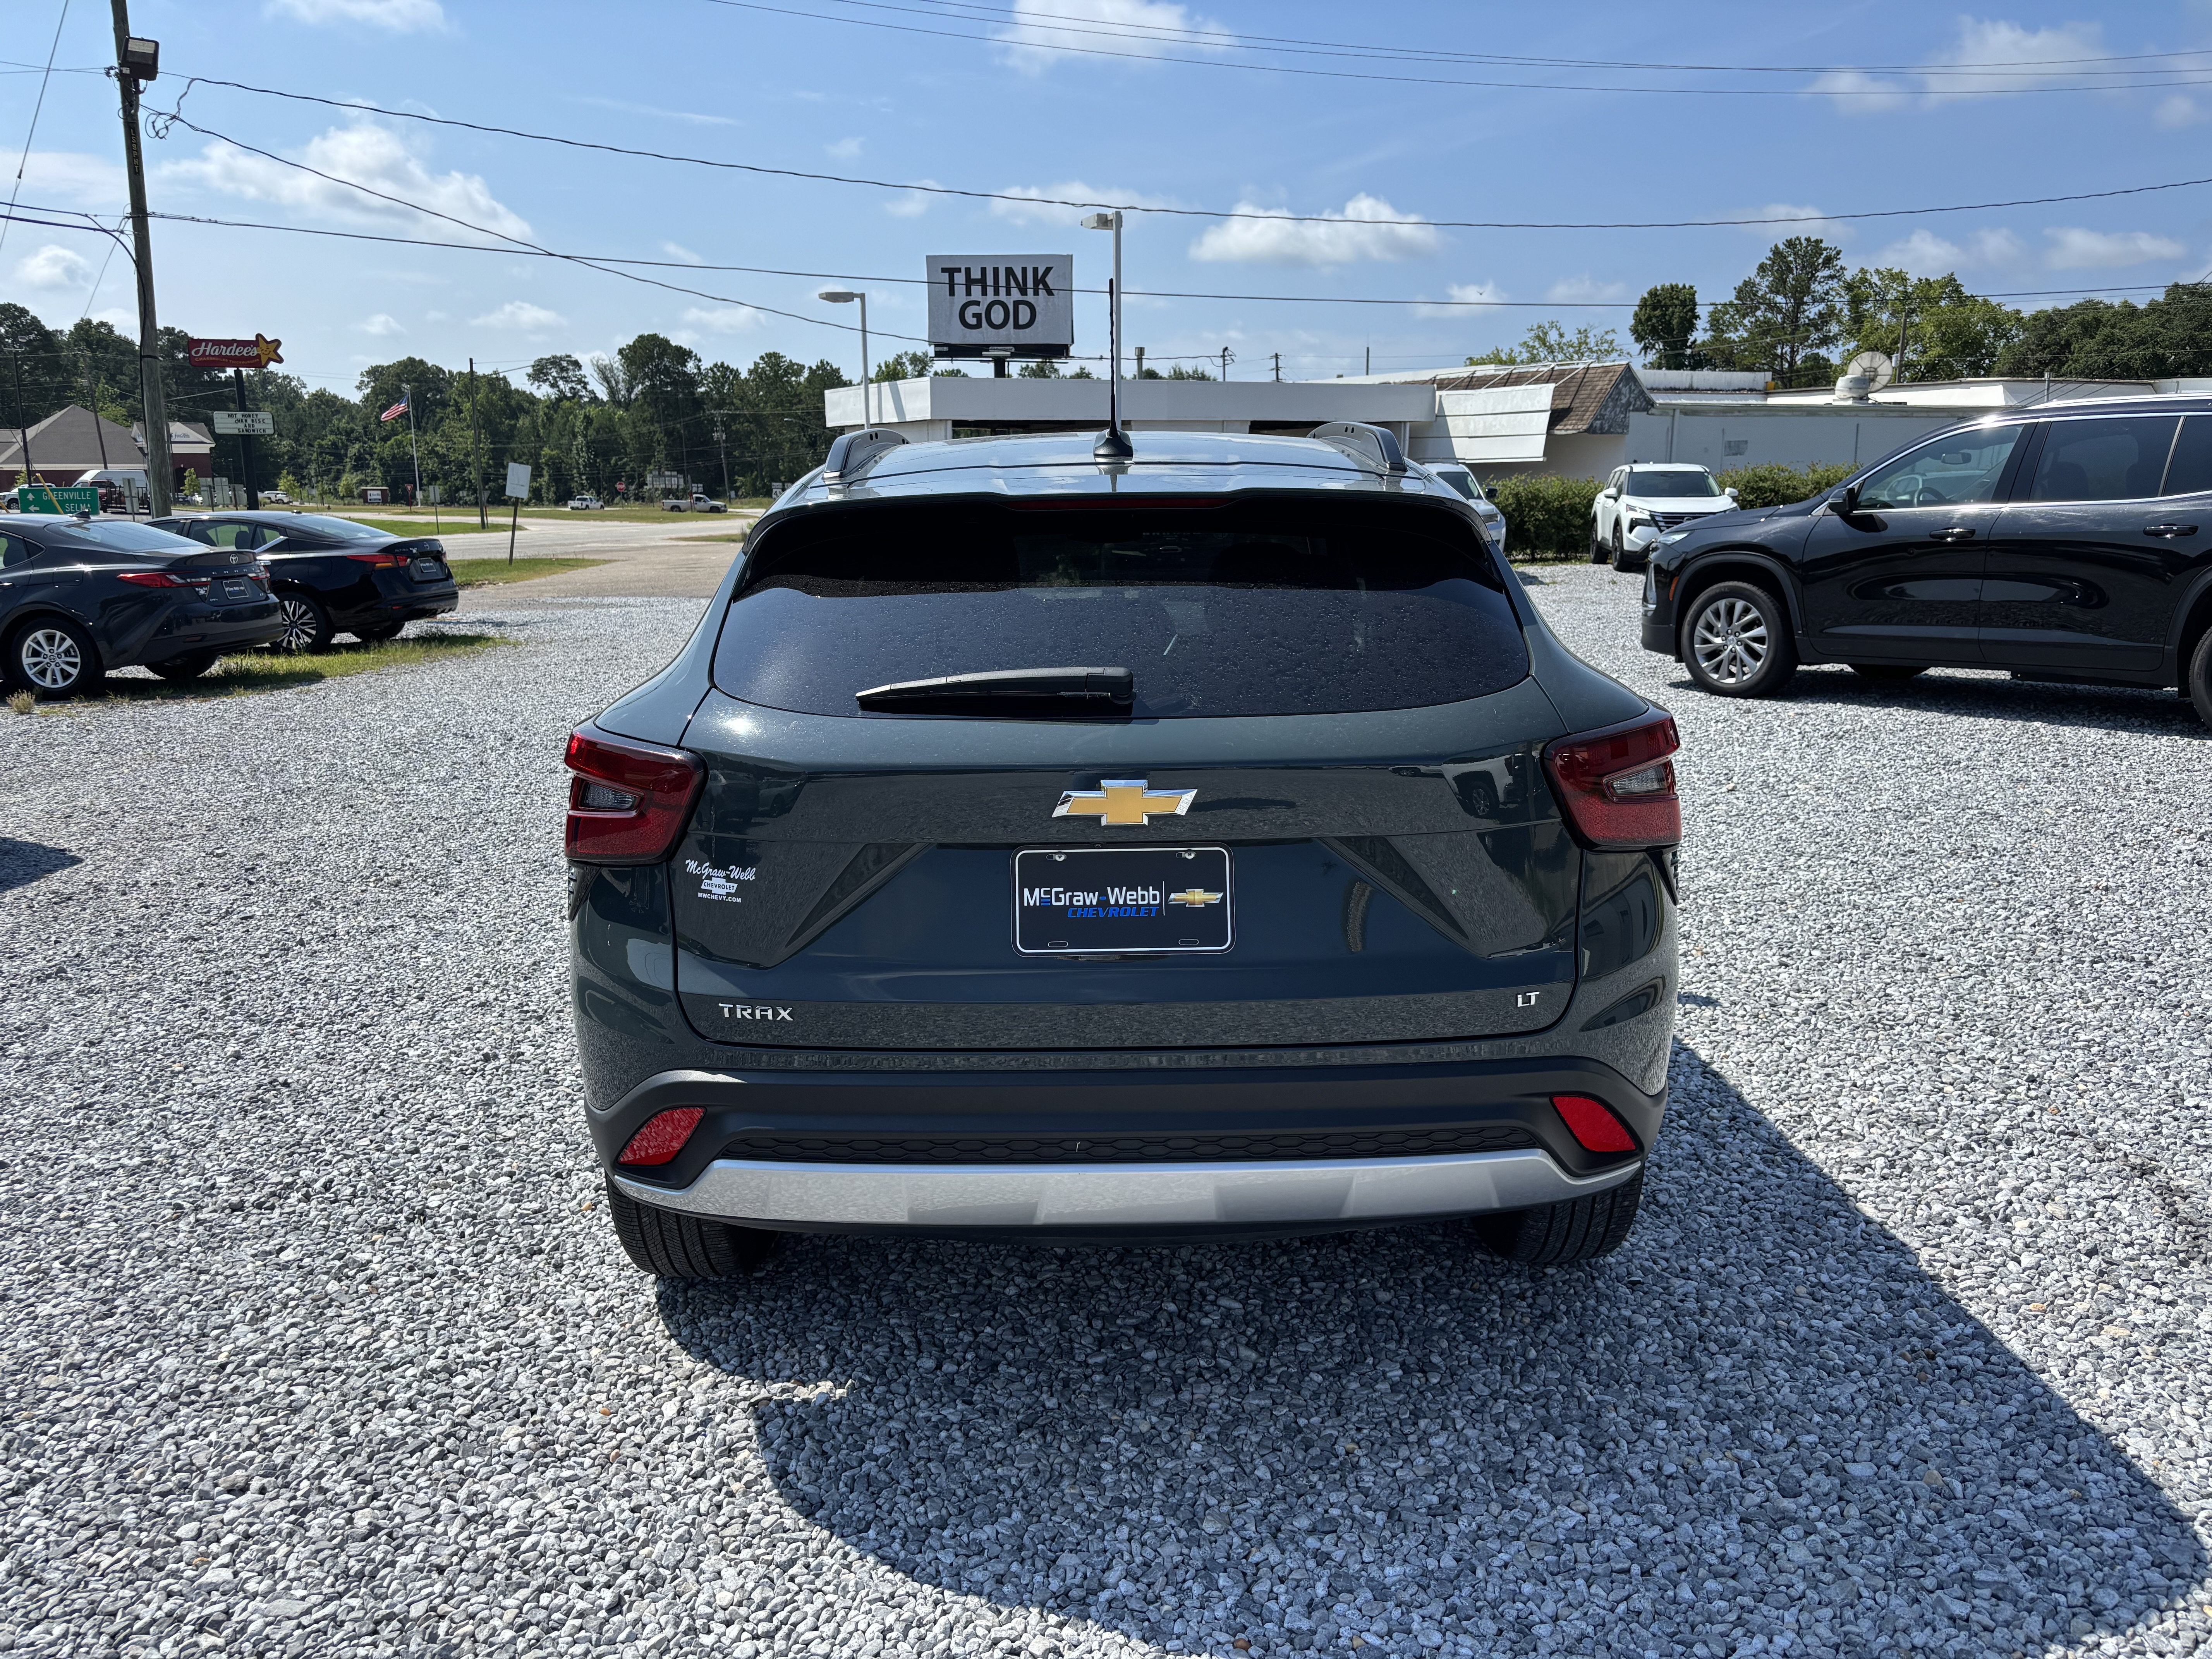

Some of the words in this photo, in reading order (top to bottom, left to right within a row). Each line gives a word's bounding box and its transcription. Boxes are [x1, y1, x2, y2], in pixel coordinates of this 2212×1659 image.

[941, 266, 1055, 297] THINK
[958, 300, 1037, 330] GOD
[191, 342, 261, 357] Hardee's
[65, 503, 92, 512] SELMA
[685, 859, 756, 881] McGraw-Webb
[703, 881, 735, 891] CHEVROLET
[698, 892, 742, 903] MWCHEVY.COM
[1024, 886, 1161, 907] McGraw-Webb
[1067, 906, 1160, 918] CHEVROLET
[1517, 991, 1540, 1008] LT
[718, 1003, 794, 1021] TRAX
